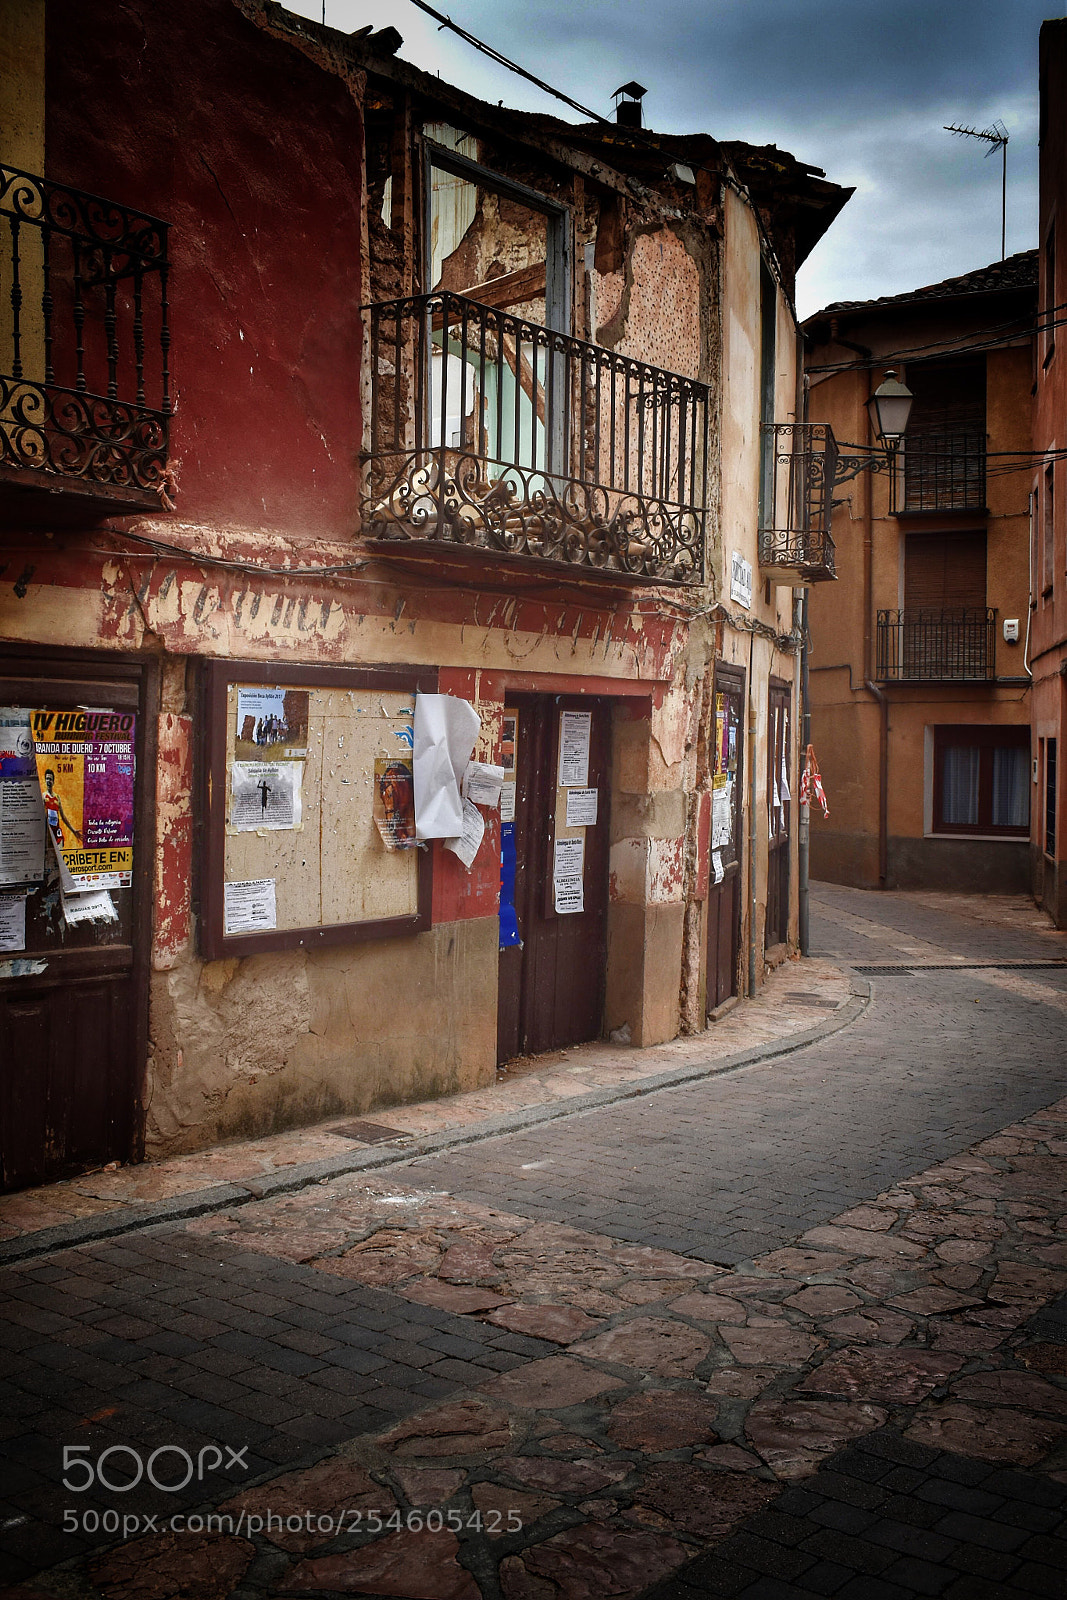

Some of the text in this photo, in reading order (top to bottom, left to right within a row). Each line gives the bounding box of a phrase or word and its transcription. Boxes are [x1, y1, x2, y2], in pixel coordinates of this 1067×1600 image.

[33, 713, 55, 731] IV
[54, 712, 133, 731] HIGUERO
[95, 731, 132, 741] FESTIVAL
[61, 743, 71, 753] DE
[72, 743, 93, 753] DUERO
[98, 743, 103, 753] 7
[104, 743, 132, 753] OCTUBRE
[57, 763, 73, 773] 5 KM
[88, 763, 106, 773] 10 KM
[110, 851, 129, 863] EN:
